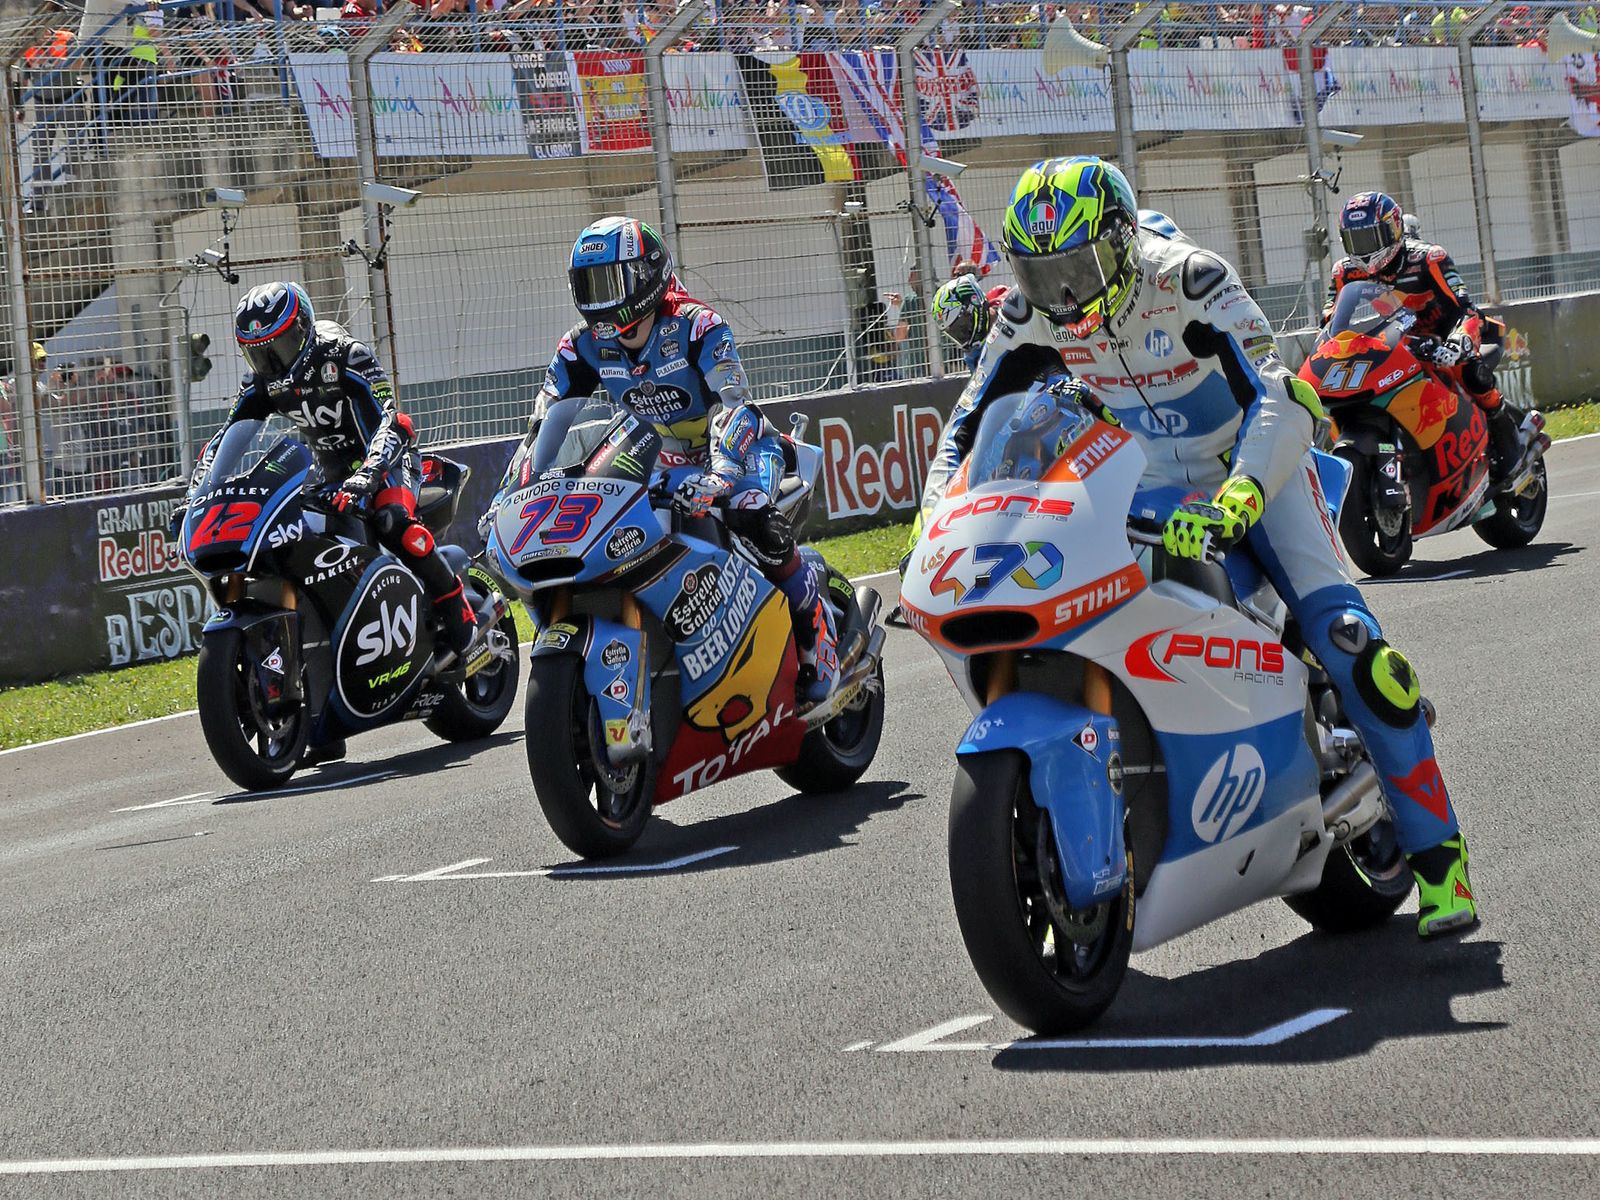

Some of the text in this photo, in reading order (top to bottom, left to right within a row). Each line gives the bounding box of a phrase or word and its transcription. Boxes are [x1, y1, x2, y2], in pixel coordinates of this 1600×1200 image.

[1031, 220, 1055, 234] agv
[581, 242, 604, 253] SHOEI
[1065, 351, 1091, 360] STIHL
[600, 368, 624, 376] Allianz
[1319, 360, 1373, 392] 41
[629, 389, 680, 406] Estrella
[634, 400, 684, 416] Galicia
[1068, 432, 1122, 480] STIHL
[207, 486, 270, 499] OAKLEY
[513, 480, 626, 505] europe energy
[97, 503, 144, 534] GRAN
[188, 501, 262, 552] 42
[510, 493, 603, 556] 73
[267, 519, 304, 550] sky
[609, 528, 640, 551] Estrella
[613, 536, 642, 557] Galicia
[304, 555, 359, 585] OAKLEY
[371, 574, 401, 599] RACING
[672, 571, 717, 625] Estrella
[680, 586, 723, 636] Galicia
[1054, 581, 1131, 625] STIHL
[355, 593, 418, 667] sky
[682, 567, 757, 681] BEER LOVERS
[672, 702, 794, 796] TOTAL
